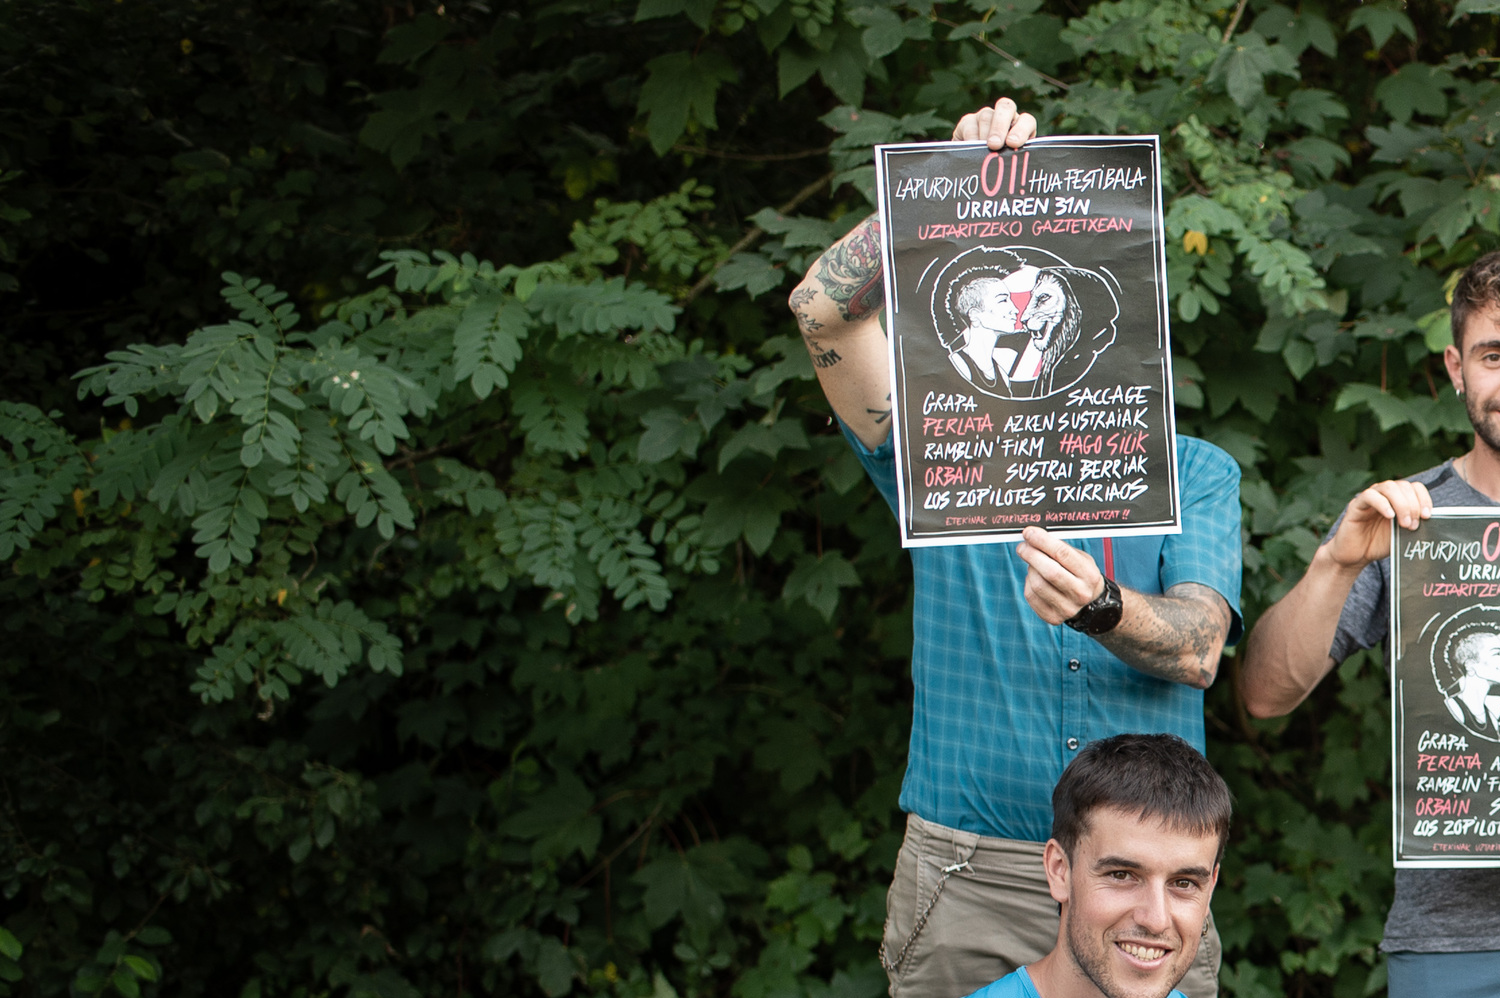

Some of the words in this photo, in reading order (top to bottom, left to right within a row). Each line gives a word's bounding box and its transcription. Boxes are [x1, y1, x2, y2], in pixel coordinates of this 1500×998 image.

[896, 175, 979, 200] LAPURDIKO
[956, 197, 1050, 220] URRIAREN
[1055, 197, 1090, 216] 31N
[918, 221, 1022, 240] UZTARITZEKO
[1032, 217, 1133, 237] GAZTETXEAN
[923, 390, 978, 415] GRAPA
[1065, 385, 1152, 407] SACCAGE
[923, 413, 994, 437] PERLATA
[1003, 414, 1055, 433] AZKEN
[1060, 433, 1102, 455] HAGO
[923, 491, 950, 511] LOS
[1404, 540, 1481, 562] LAPURDIKO
[1417, 730, 1469, 752] GRAPA
[1417, 752, 1482, 772] PERLATA
[1413, 819, 1438, 837] LOS
